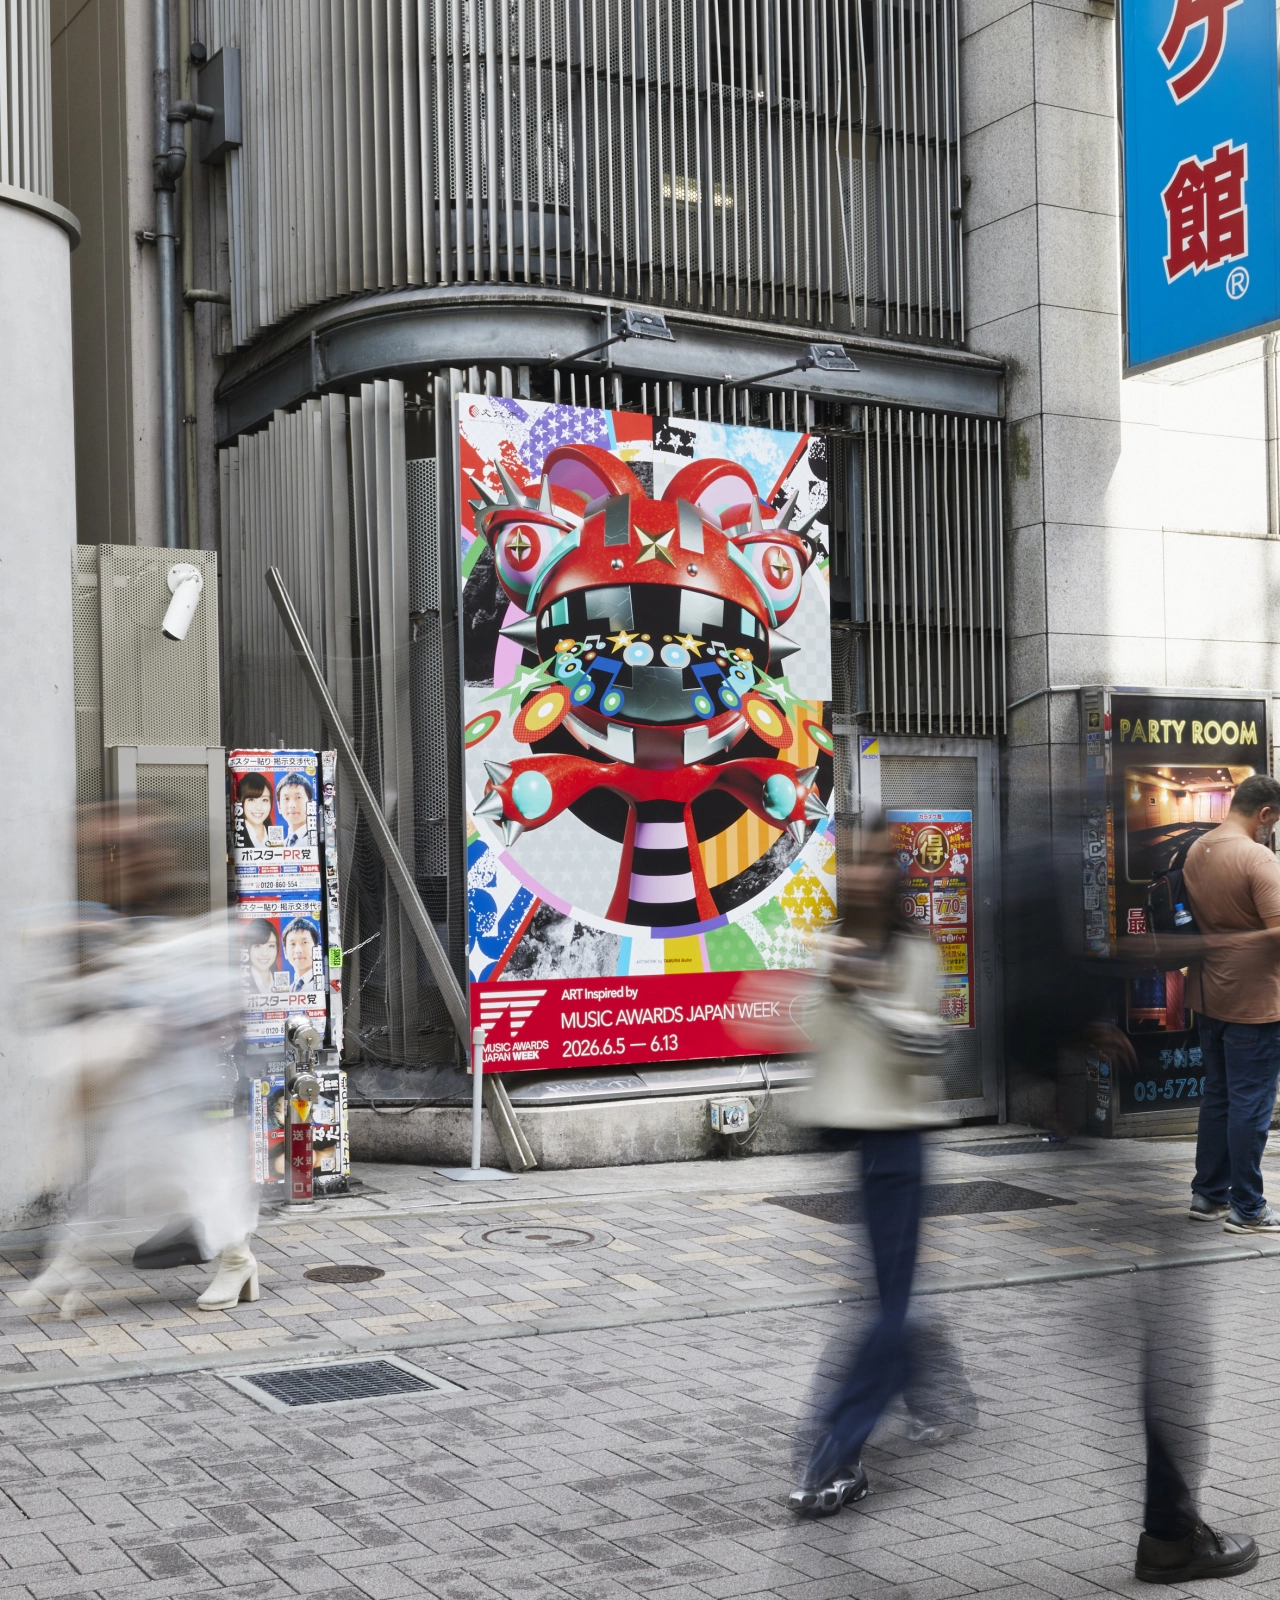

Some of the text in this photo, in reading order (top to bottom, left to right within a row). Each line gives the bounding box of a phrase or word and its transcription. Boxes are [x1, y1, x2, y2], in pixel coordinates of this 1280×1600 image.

[1119, 718, 1257, 745] PARTY ROOM
[234, 802, 245, 847] あなた
[242, 849, 311, 861] ポスターPR党
[919, 834, 944, 865] 得
[247, 994, 317, 1007] ポスターPR党
[561, 986, 638, 1002] ART Inspired by
[561, 1001, 780, 1029] MUSIC AWARDS JAPAN WEEK
[482, 1040, 549, 1053] MUSIC AWARDS
[482, 1051, 540, 1063] JAPAN WEEK
[562, 1037, 626, 1058] 2026.6.5
[650, 1034, 679, 1053] 6.13
[293, 1130, 304, 1193] 送水口
